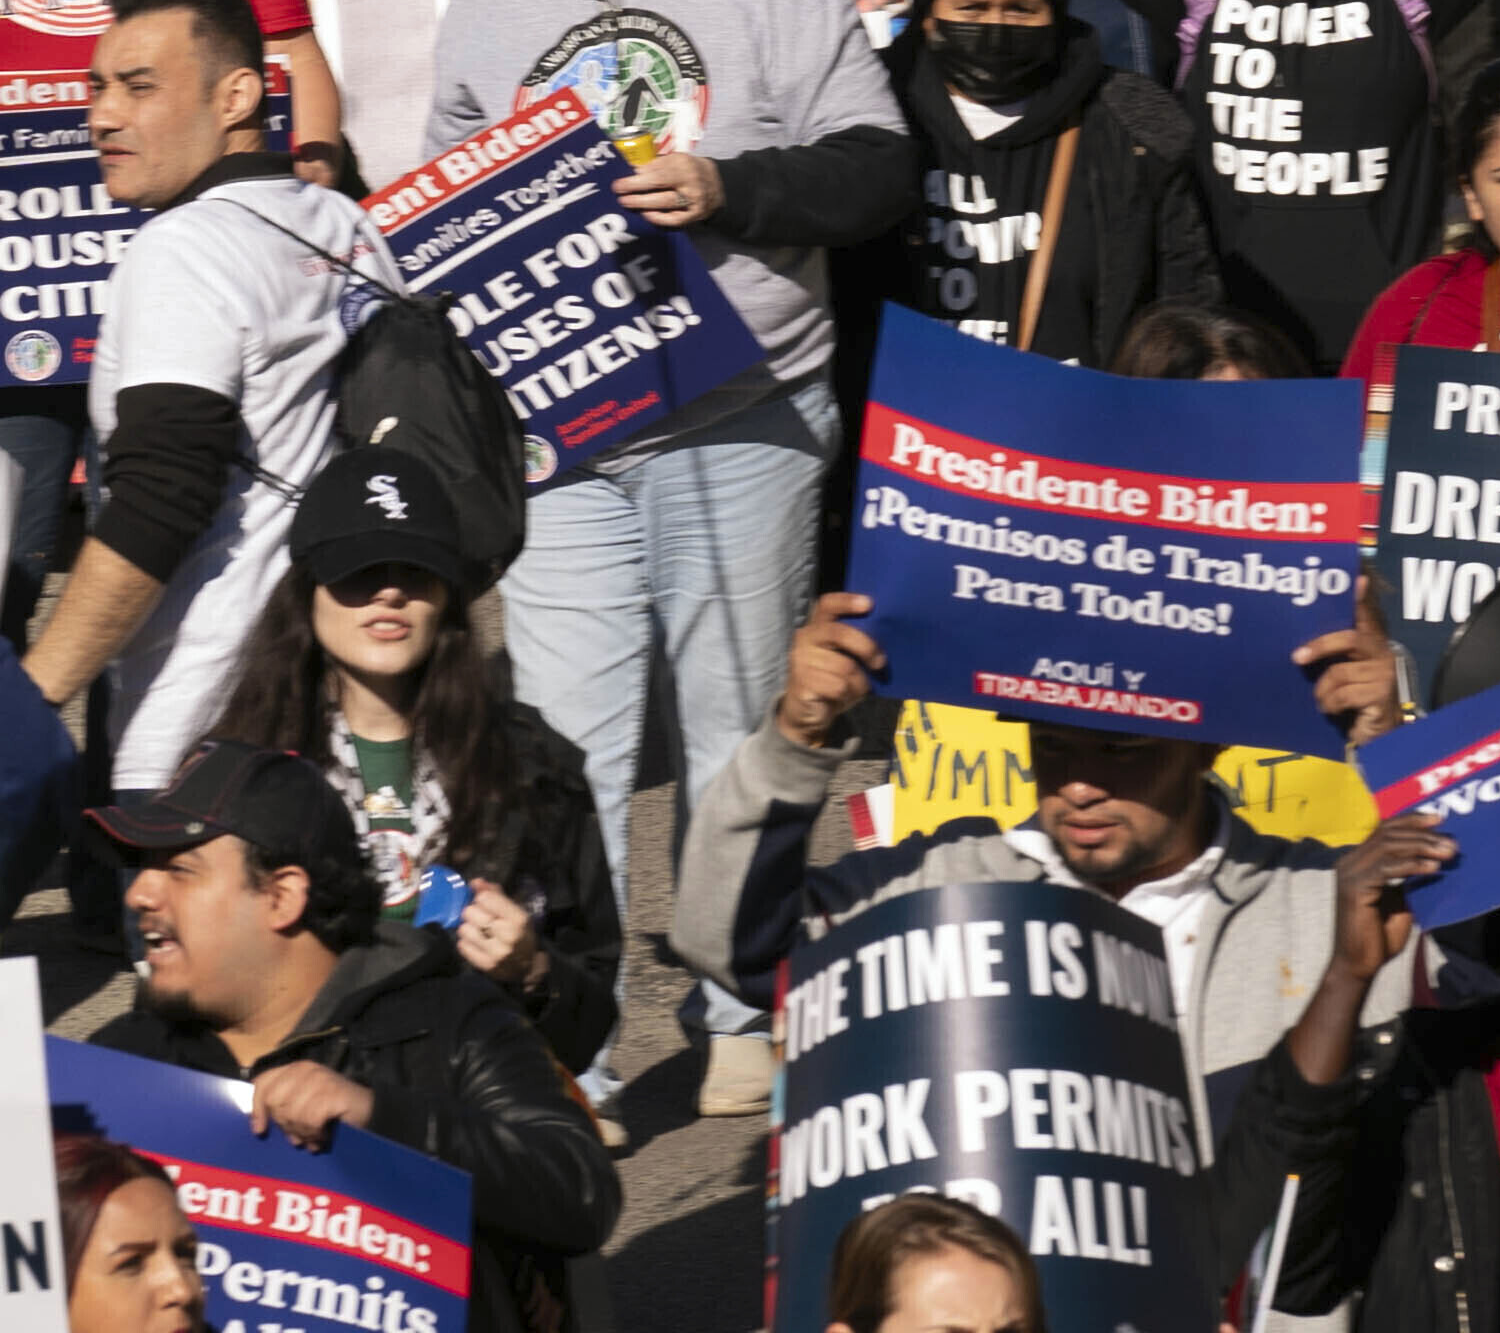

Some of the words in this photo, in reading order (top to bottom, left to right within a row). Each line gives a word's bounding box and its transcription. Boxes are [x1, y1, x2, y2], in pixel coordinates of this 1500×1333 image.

[1209, 43, 1277, 89] TO
[440, 99, 581, 183] Biden:
[1207, 92, 1302, 141] THE
[1212, 144, 1389, 196] PEOPLE
[524, 213, 638, 289] FOR
[889, 422, 1149, 517] Presidente
[1158, 484, 1326, 534] Biden:
[863, 488, 1087, 565] ¡Permisos
[1094, 537, 1155, 576] de
[1162, 544, 1351, 607] Trabajo
[954, 564, 1065, 612] Para
[1073, 581, 1232, 637] Todos!
[976, 672, 1199, 724] TRABAJANDO
[780, 1078, 938, 1207] WORK
[954, 1068, 1195, 1177] PERMITS
[270, 1190, 431, 1274] Biden:
[1029, 1175, 1152, 1266] ALL!
